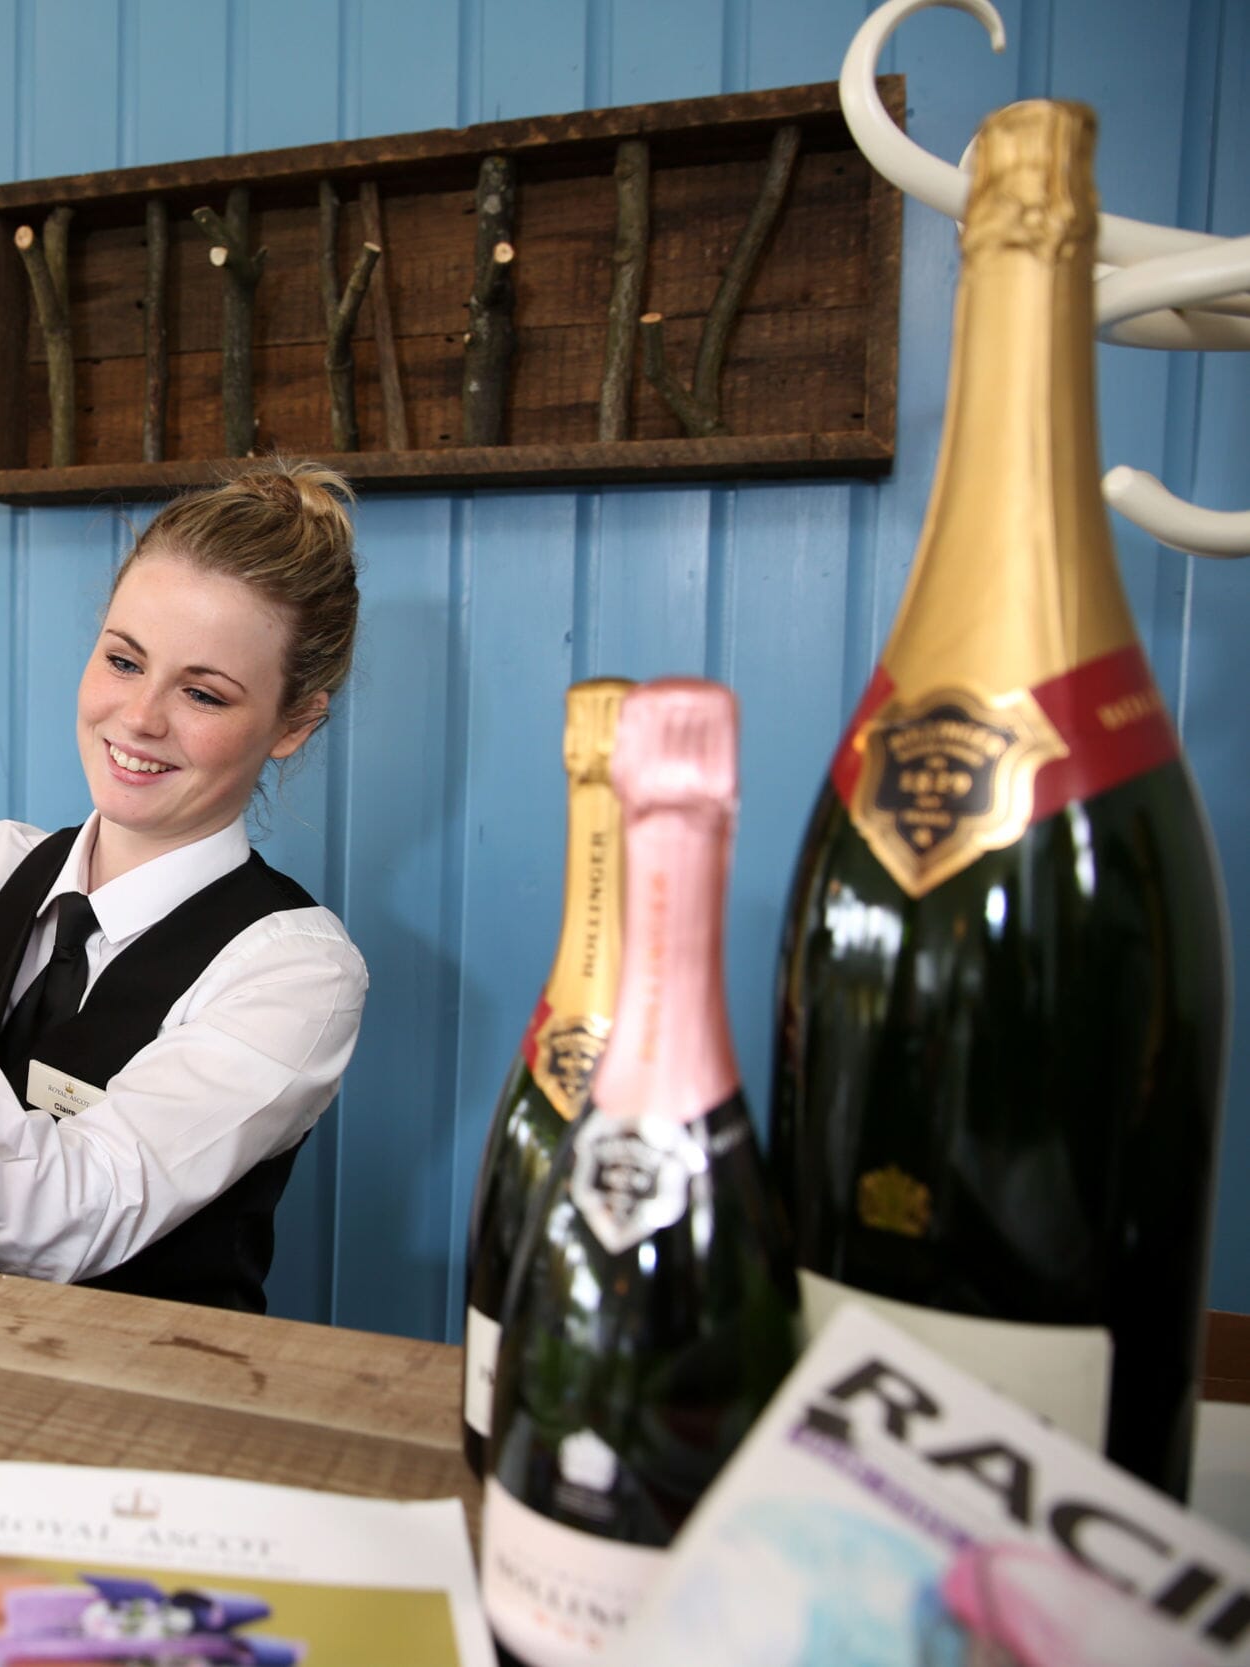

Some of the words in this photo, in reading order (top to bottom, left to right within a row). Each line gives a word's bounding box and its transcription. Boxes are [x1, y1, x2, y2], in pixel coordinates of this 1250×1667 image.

[582, 831, 605, 979] BOLLINGER
[48, 1085, 67, 1098] ROYAL
[70, 1095, 90, 1107] ASCOT
[137, 1524, 275, 1558] ASCOT
